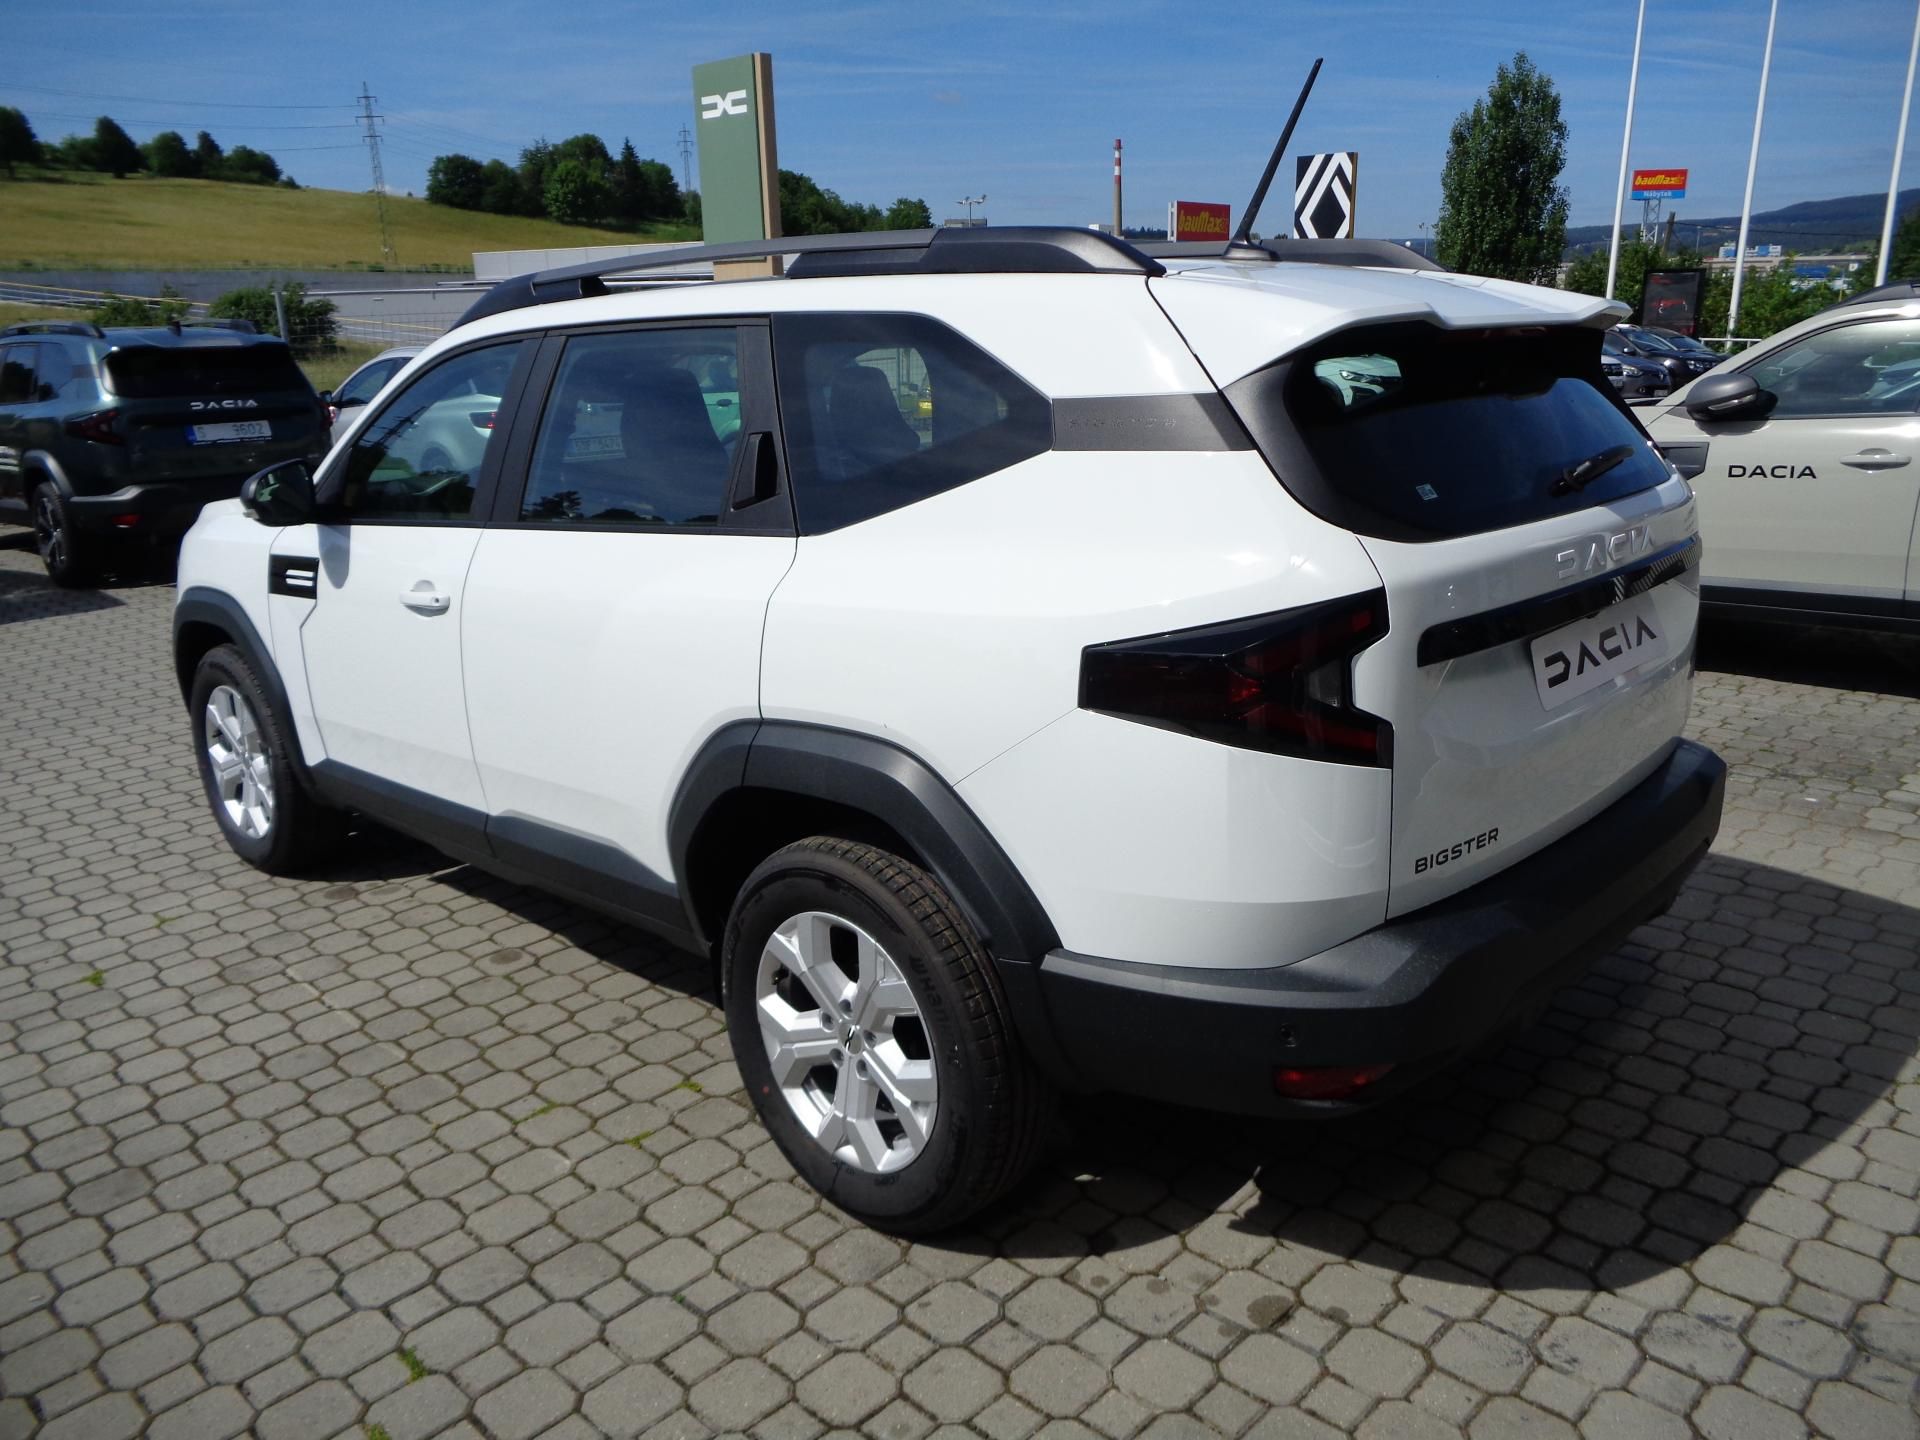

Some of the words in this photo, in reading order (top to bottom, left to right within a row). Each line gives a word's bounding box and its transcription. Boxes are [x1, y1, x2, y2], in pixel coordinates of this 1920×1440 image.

[190, 399, 258, 410] DACIA
[1728, 465, 1817, 479] DACIA
[1556, 524, 1656, 580] DACIA
[1543, 615, 1658, 689] DACIA
[1414, 827, 1499, 875] BIGSTER
